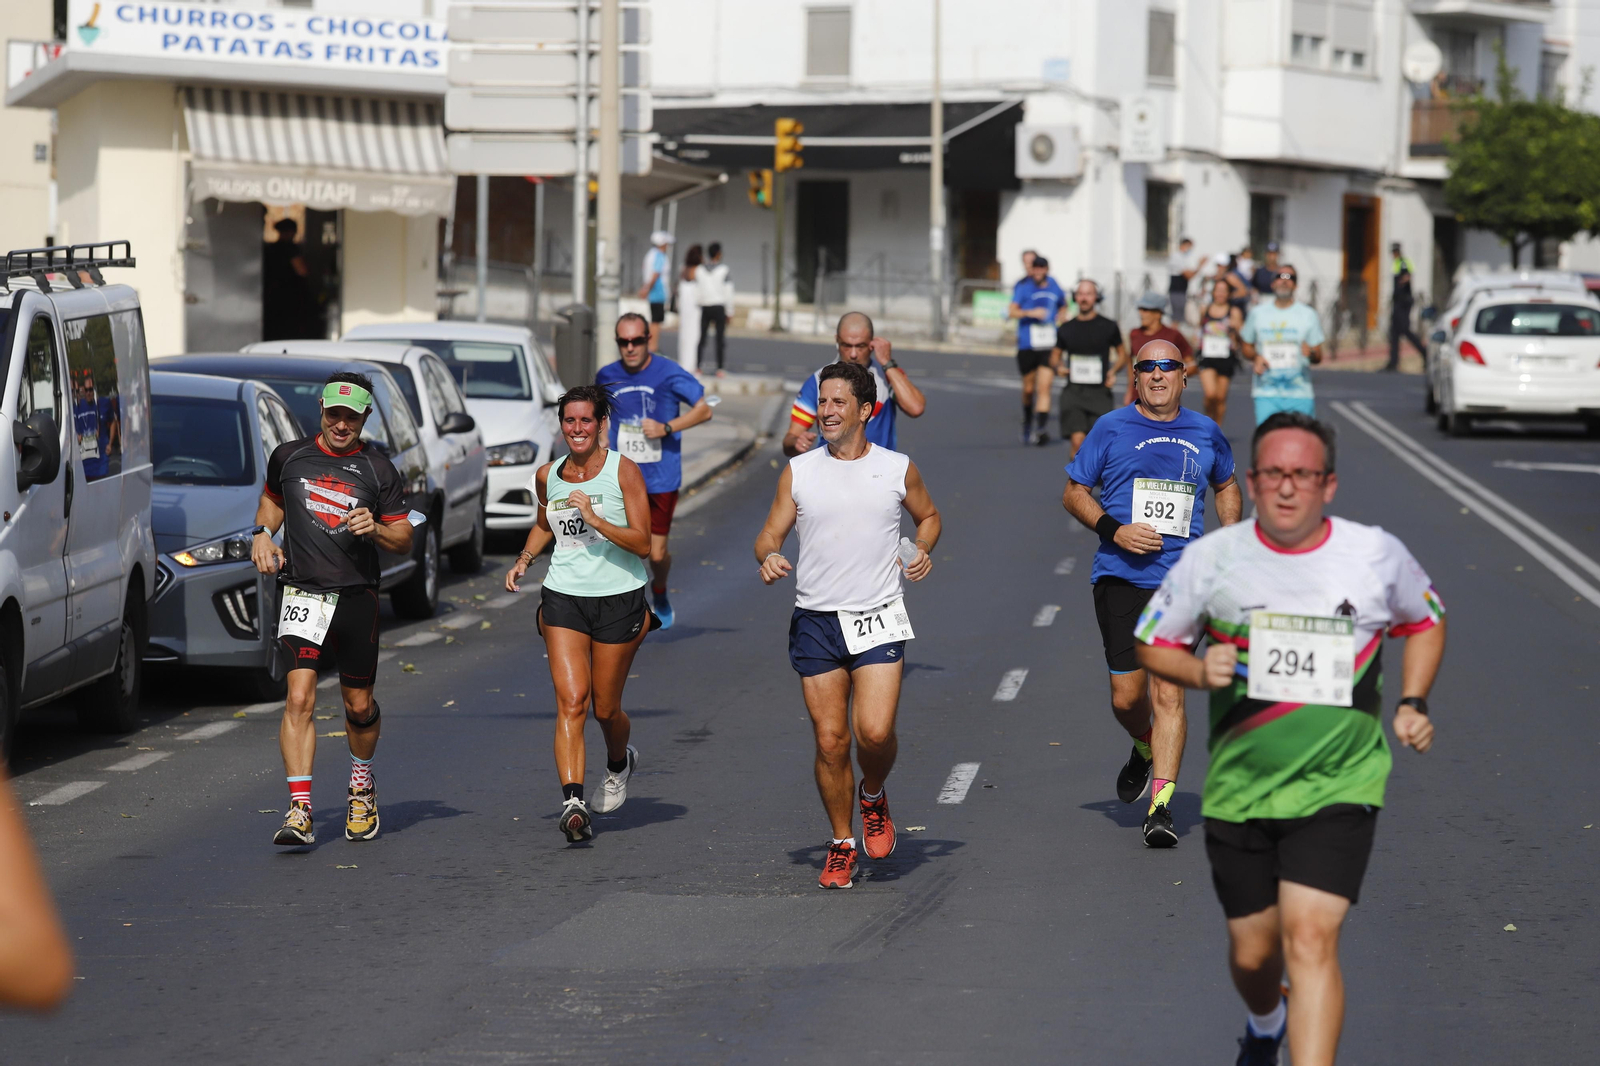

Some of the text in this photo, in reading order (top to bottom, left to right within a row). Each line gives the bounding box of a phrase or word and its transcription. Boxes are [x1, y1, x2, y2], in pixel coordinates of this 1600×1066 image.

[116, 4, 275, 32] CHURROS
[307, 16, 449, 41] CHOCOL
[162, 33, 440, 68] PATATAS FRITAS
[266, 176, 356, 205] ONUTAPI
[625, 440, 646, 453] 153
[1178, 439, 1199, 454] HUELVA
[1147, 482, 1167, 491] VUELTA
[1168, 483, 1173, 491] A
[1144, 501, 1175, 520] 592
[559, 518, 588, 536] 262
[283, 604, 310, 623] 263
[854, 614, 885, 637] 271
[1268, 649, 1315, 677] 294
